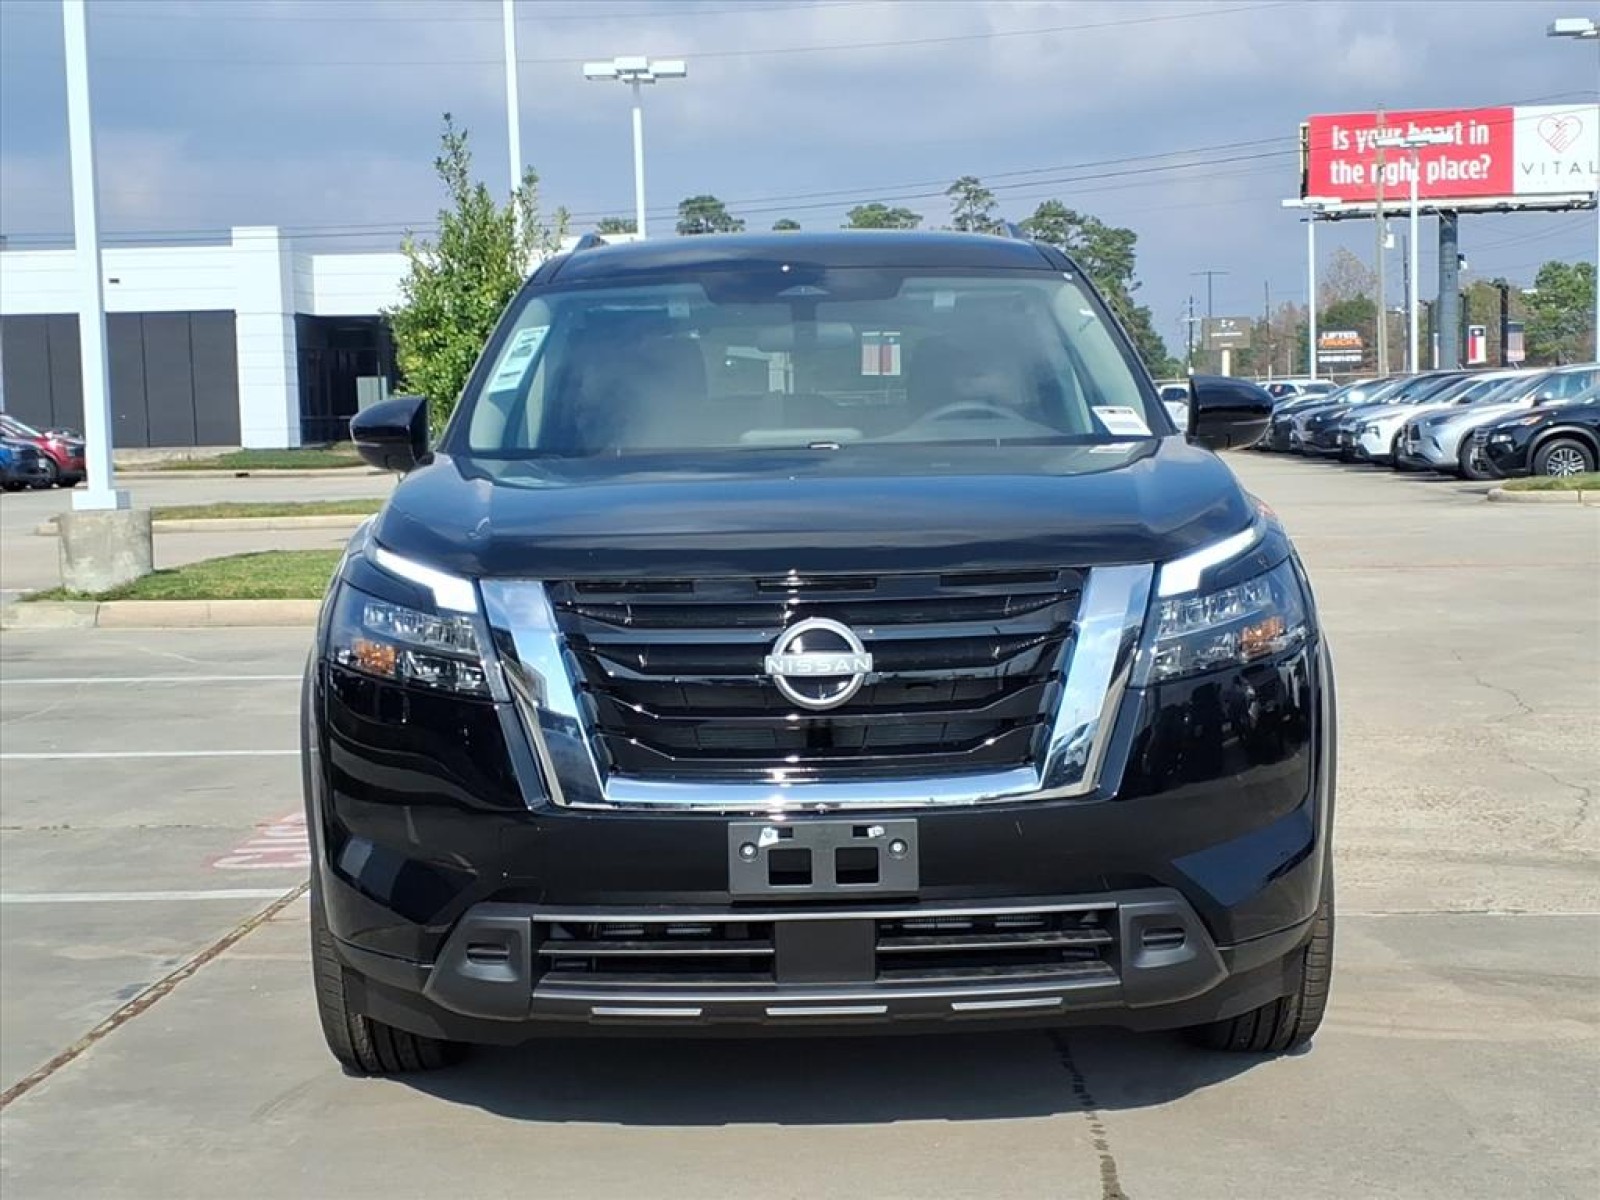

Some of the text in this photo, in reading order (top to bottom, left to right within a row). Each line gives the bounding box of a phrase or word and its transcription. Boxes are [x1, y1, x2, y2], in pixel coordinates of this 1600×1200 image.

[1332, 125, 1349, 151] Is
[1469, 120, 1490, 145] in
[1330, 159, 1364, 185] the
[1427, 154, 1491, 186] place?
[1521, 161, 1600, 176] VITAL
[767, 657, 871, 674] NISSAN
